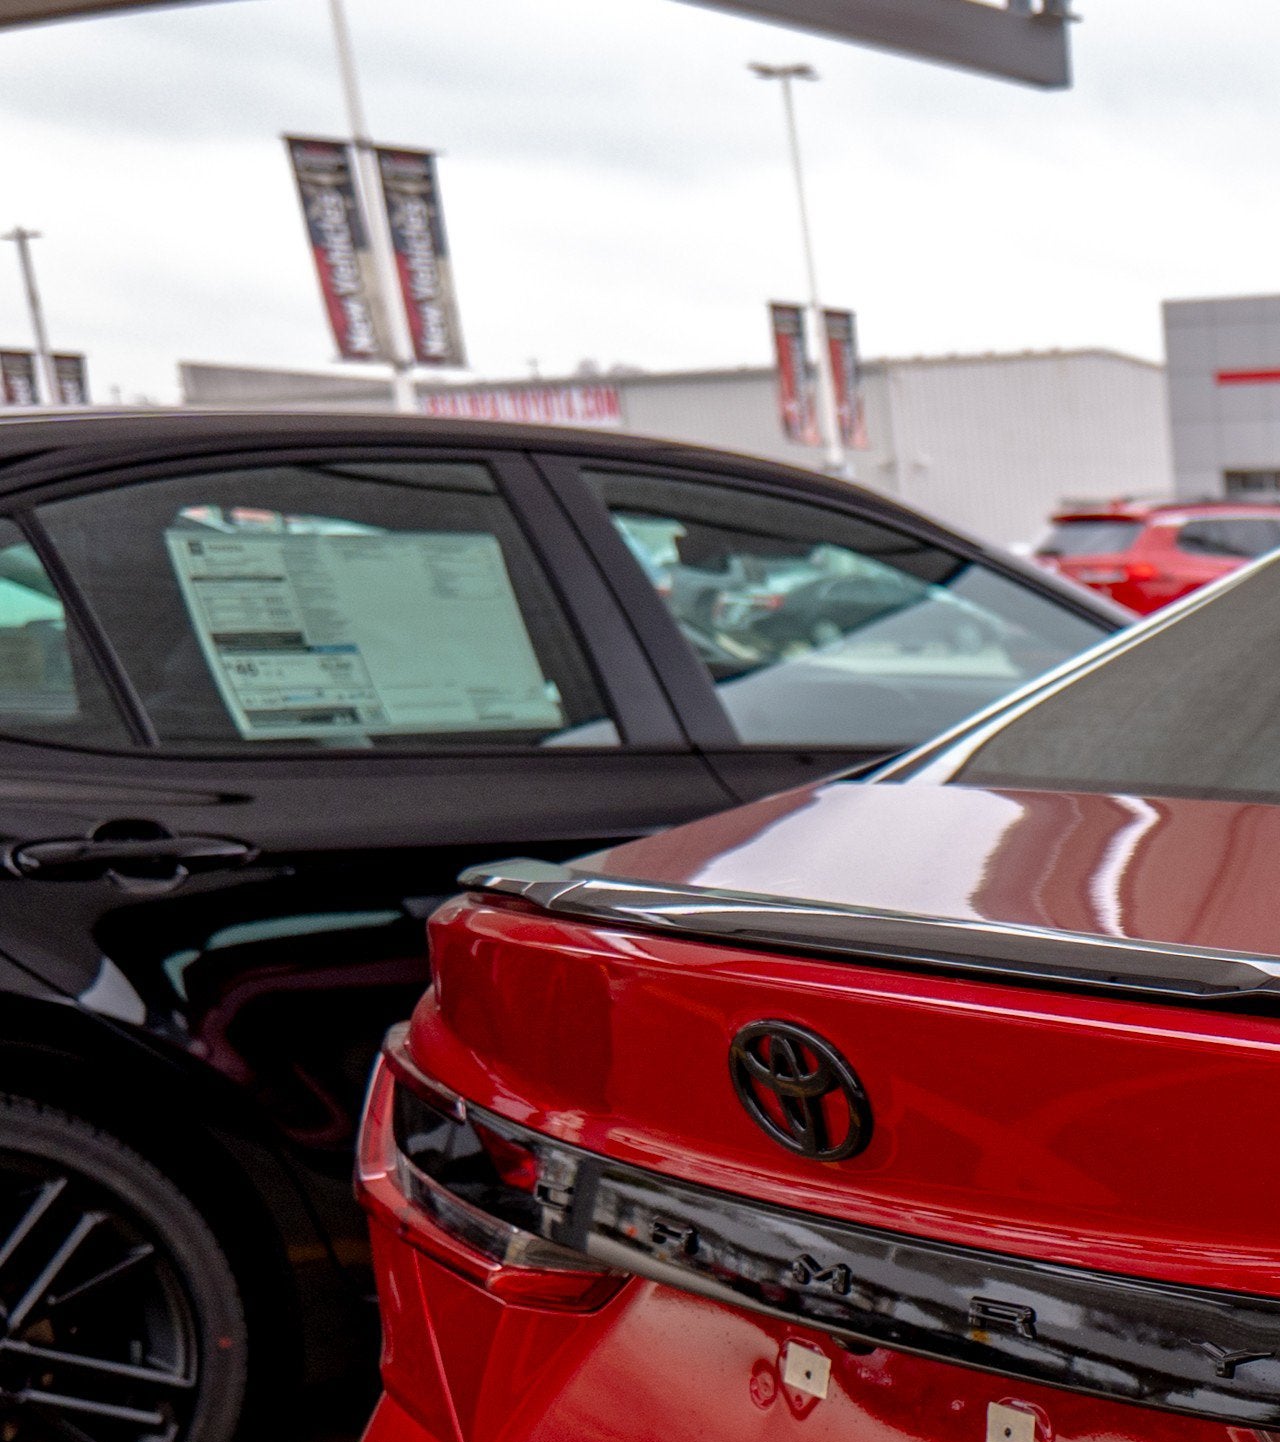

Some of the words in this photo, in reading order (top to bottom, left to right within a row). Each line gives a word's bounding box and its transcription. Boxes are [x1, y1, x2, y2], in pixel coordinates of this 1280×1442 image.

[317, 189, 361, 296] Vehicles
[397, 196, 440, 300] Vehicles
[343, 300, 376, 352] New
[418, 303, 448, 355] New
[533, 1179, 1276, 1379] CAMRY
